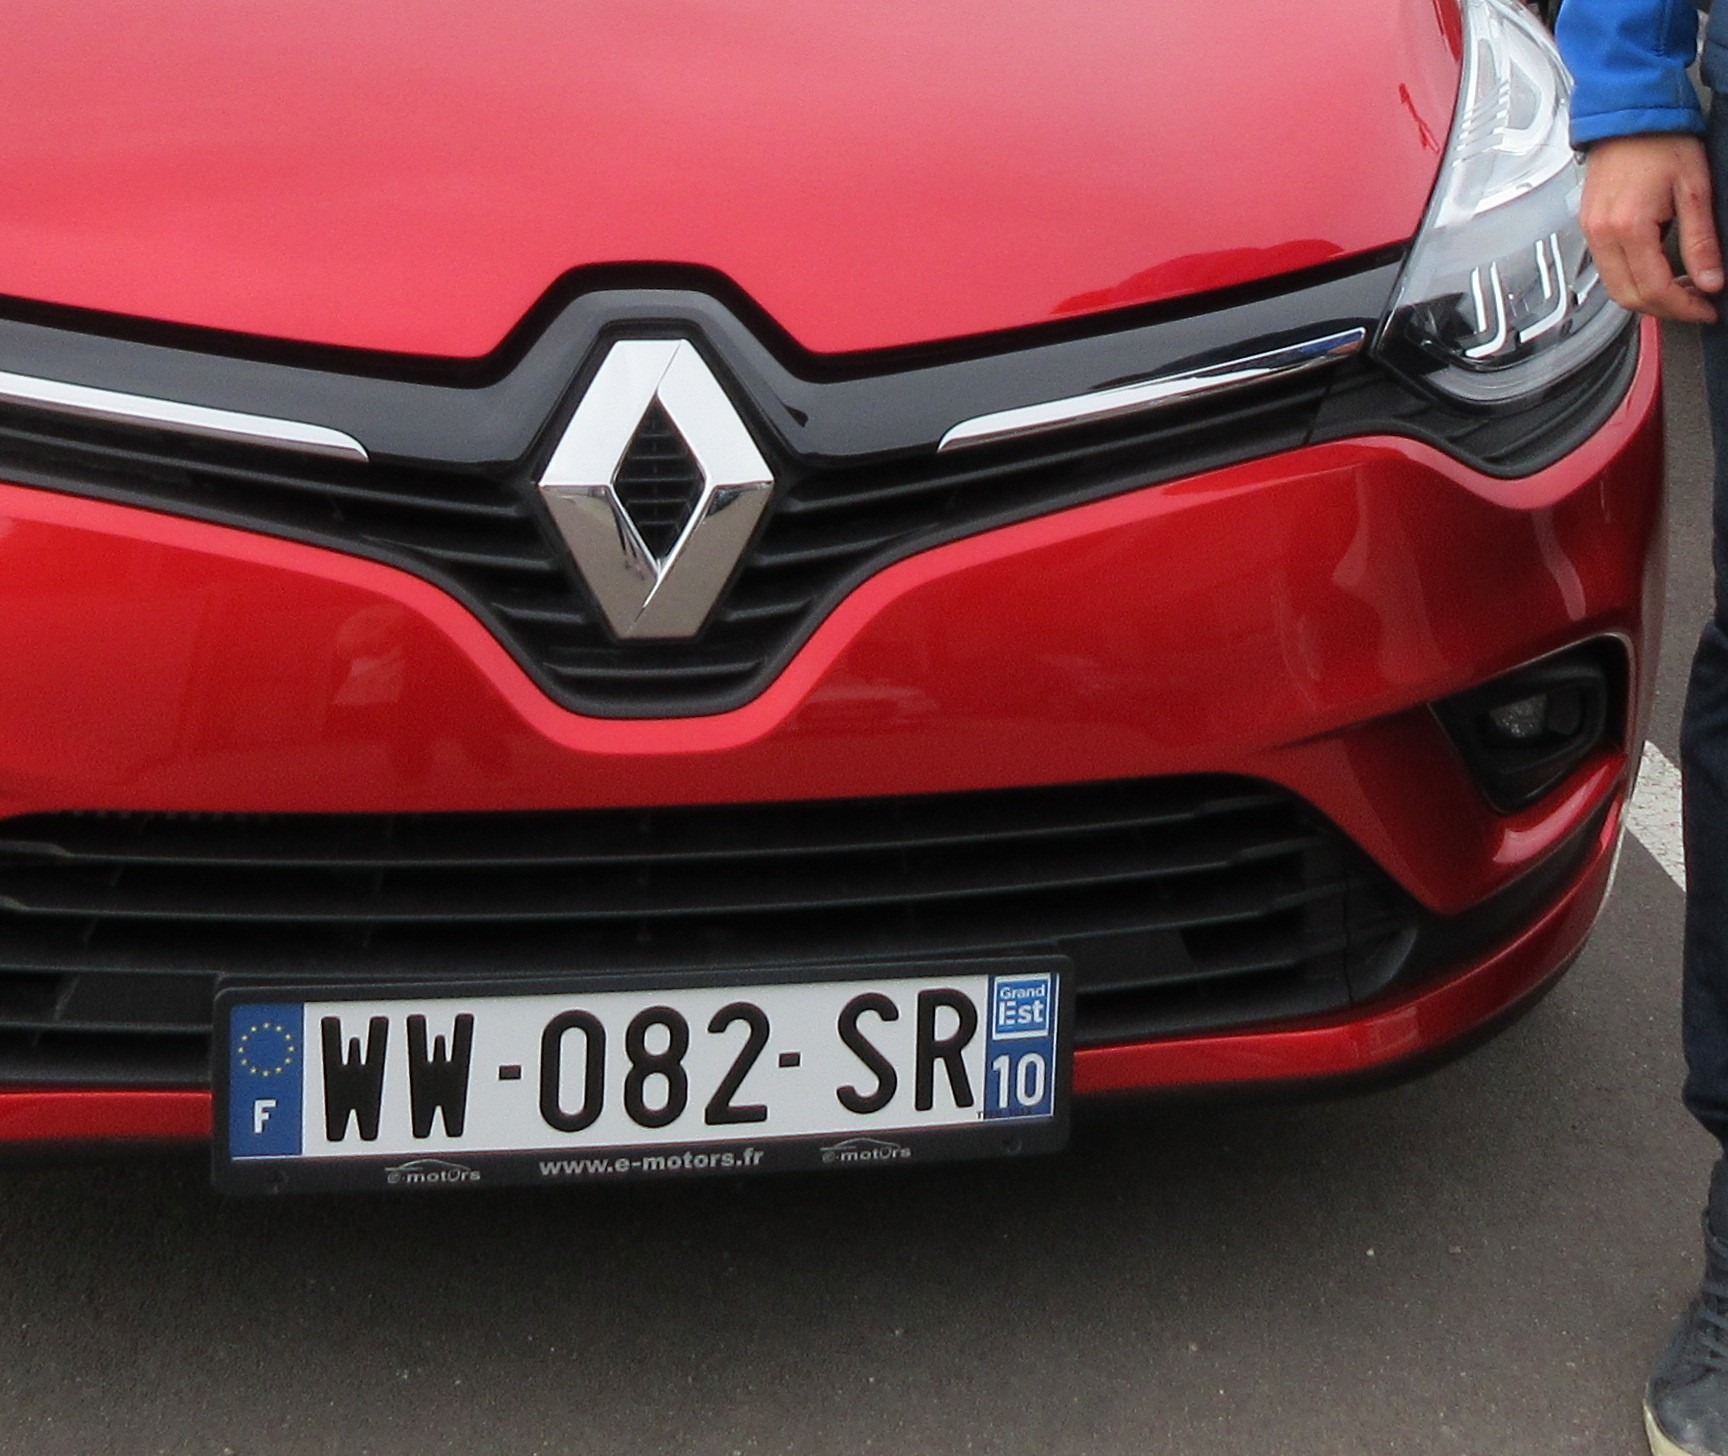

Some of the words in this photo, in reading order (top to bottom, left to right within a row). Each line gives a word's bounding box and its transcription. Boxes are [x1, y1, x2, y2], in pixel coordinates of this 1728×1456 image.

[1000, 984, 1045, 999] Grand
[998, 999, 1044, 1026] Est
[992, 1052, 1046, 1109] 10
[253, 1099, 277, 1134] F
[539, 1147, 765, 1176] www.e-motors.fr
